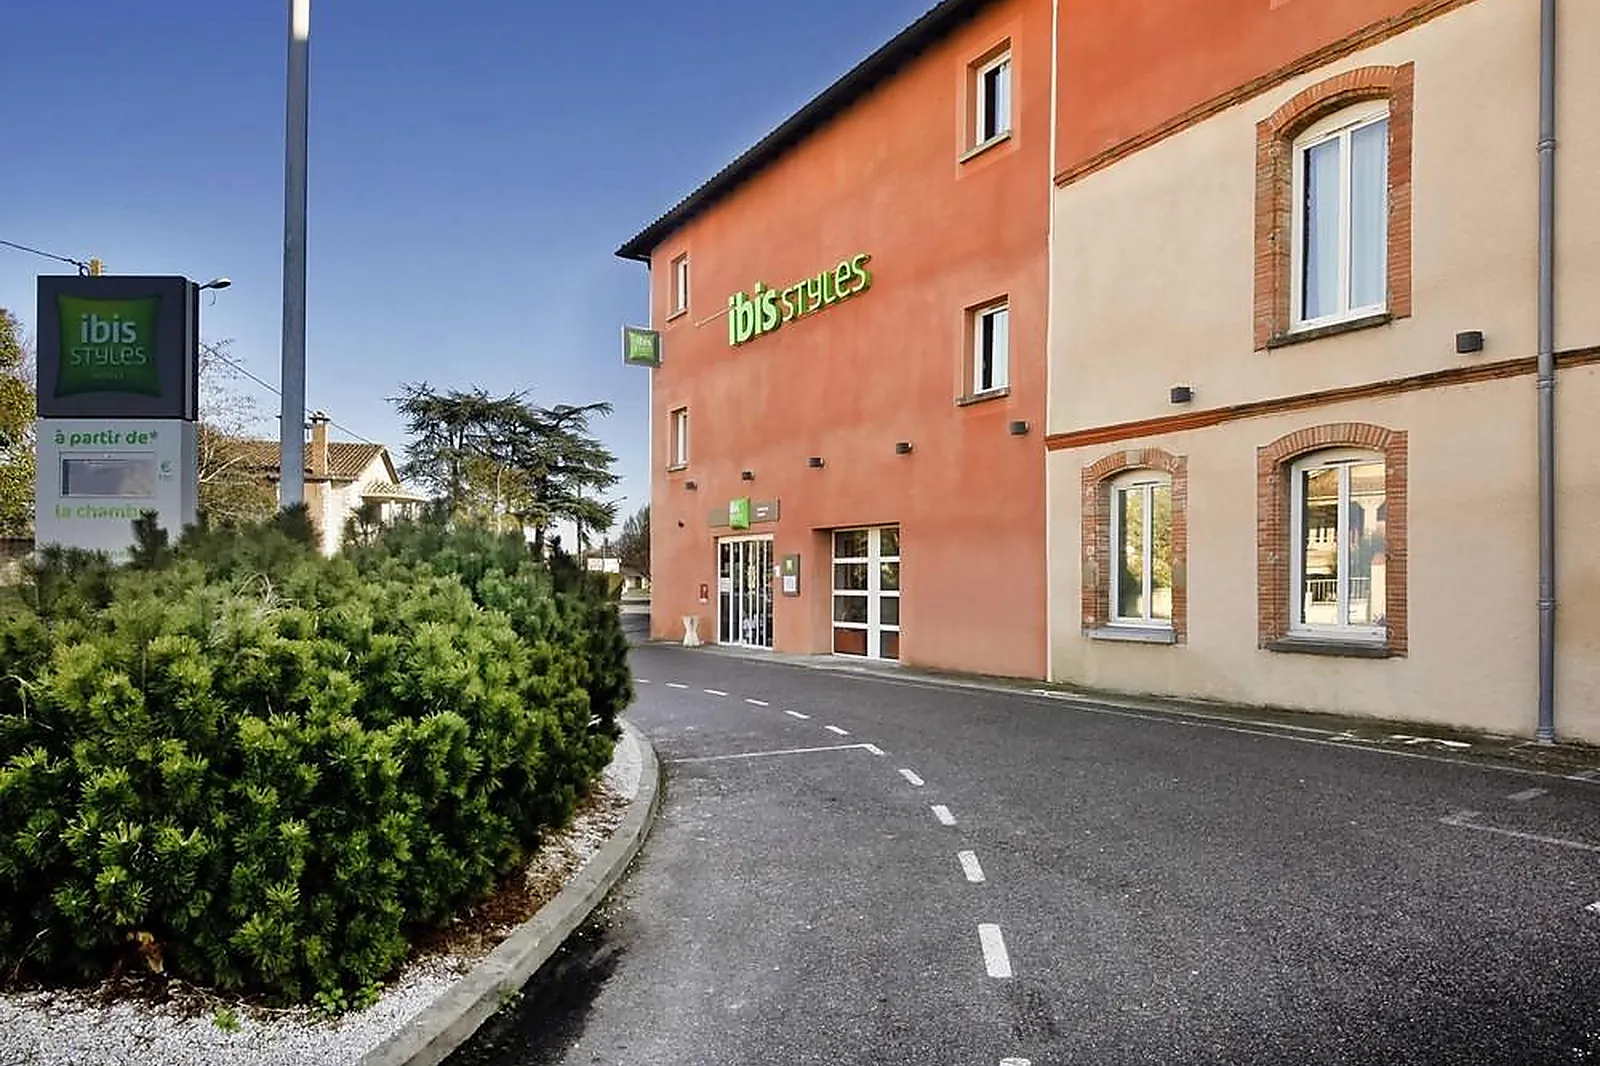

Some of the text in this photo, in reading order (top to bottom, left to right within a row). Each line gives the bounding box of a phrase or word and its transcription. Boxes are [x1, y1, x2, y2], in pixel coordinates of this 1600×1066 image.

[728, 280, 778, 346] ibis
[80, 313, 137, 344] ibis
[70, 430, 121, 446] partir
[76, 504, 142, 519] chamb
